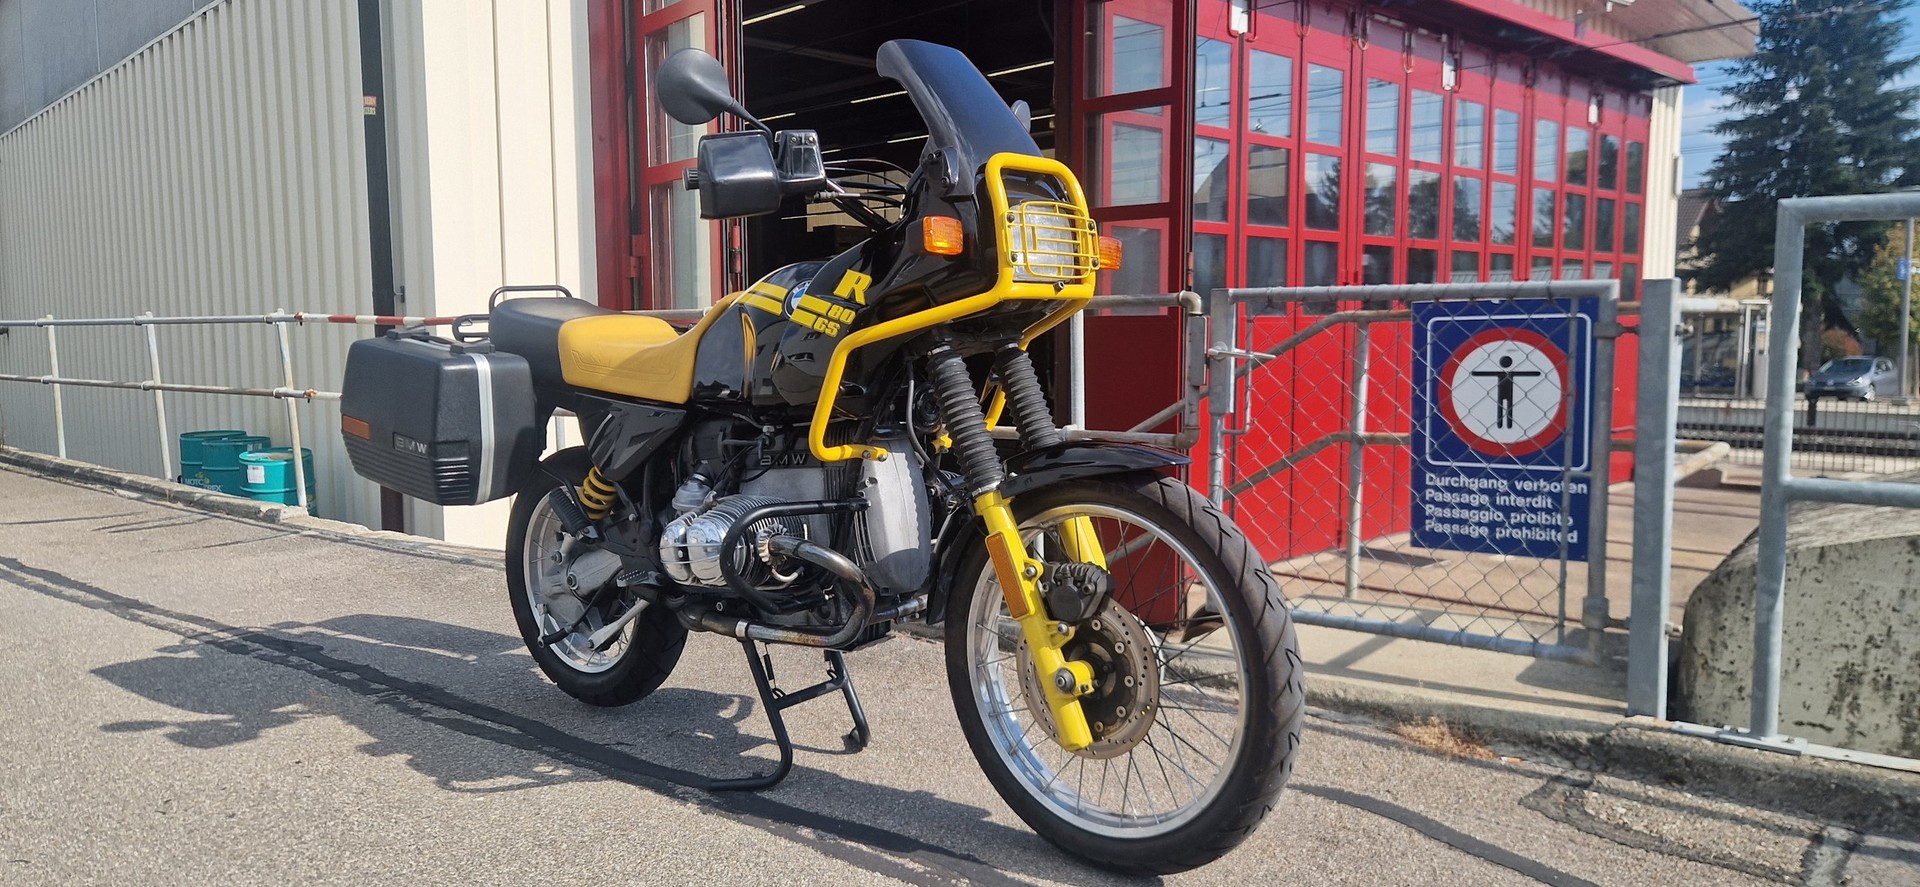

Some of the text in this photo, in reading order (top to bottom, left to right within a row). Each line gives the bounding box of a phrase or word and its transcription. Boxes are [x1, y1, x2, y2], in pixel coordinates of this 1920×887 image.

[833, 268, 873, 306] R
[826, 304, 856, 325] 80
[813, 317, 841, 338] GS
[396, 436, 428, 454] BMW
[760, 453, 806, 466] BMW
[1425, 472, 1508, 493] Durchgang
[1425, 488, 1553, 509] Passage interdit
[1425, 503, 1574, 527] Passaggio proibito
[1425, 519, 1489, 539] Passage
